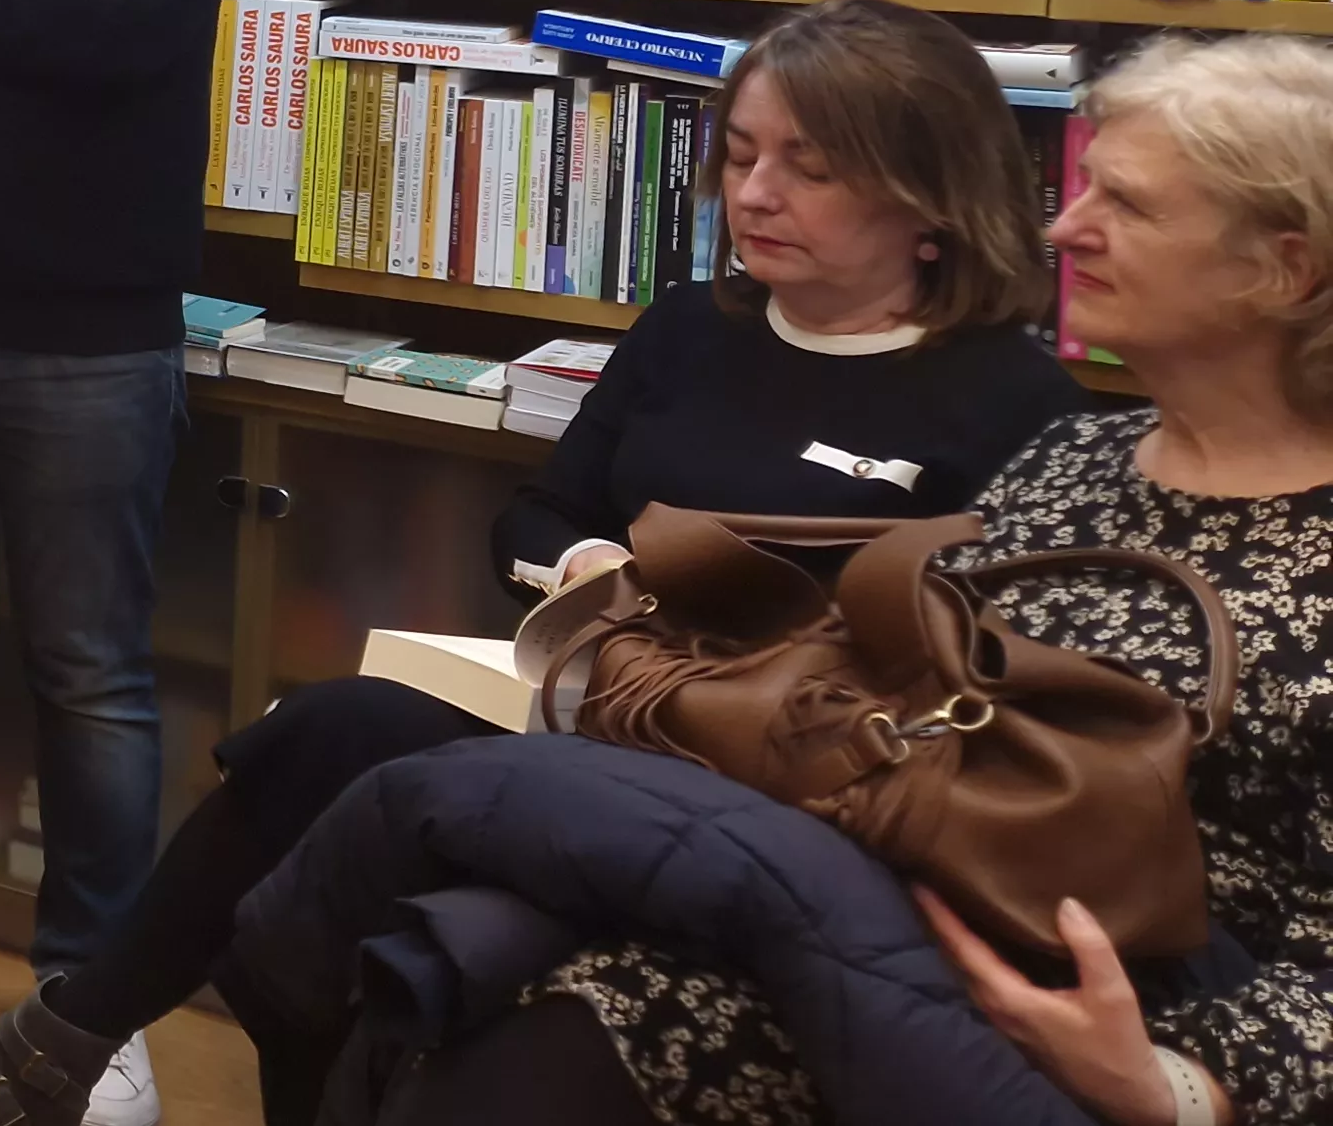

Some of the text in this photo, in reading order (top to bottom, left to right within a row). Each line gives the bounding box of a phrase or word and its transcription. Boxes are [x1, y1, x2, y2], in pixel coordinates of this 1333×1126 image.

[240, 10, 259, 62] SAURA
[331, 37, 460, 61] CARLOS SAURA
[585, 32, 705, 62] NUESTRO CUERPO
[234, 65, 255, 125] CARLOS
[261, 12, 285, 127] CARLOS SAURA
[287, 13, 312, 129] CARLOS SAURA
[554, 97, 567, 196] ILUMINA TUS SOMBRAS
[590, 114, 606, 206] Altamente sensible
[500, 172, 514, 228] DIGNIDAD
